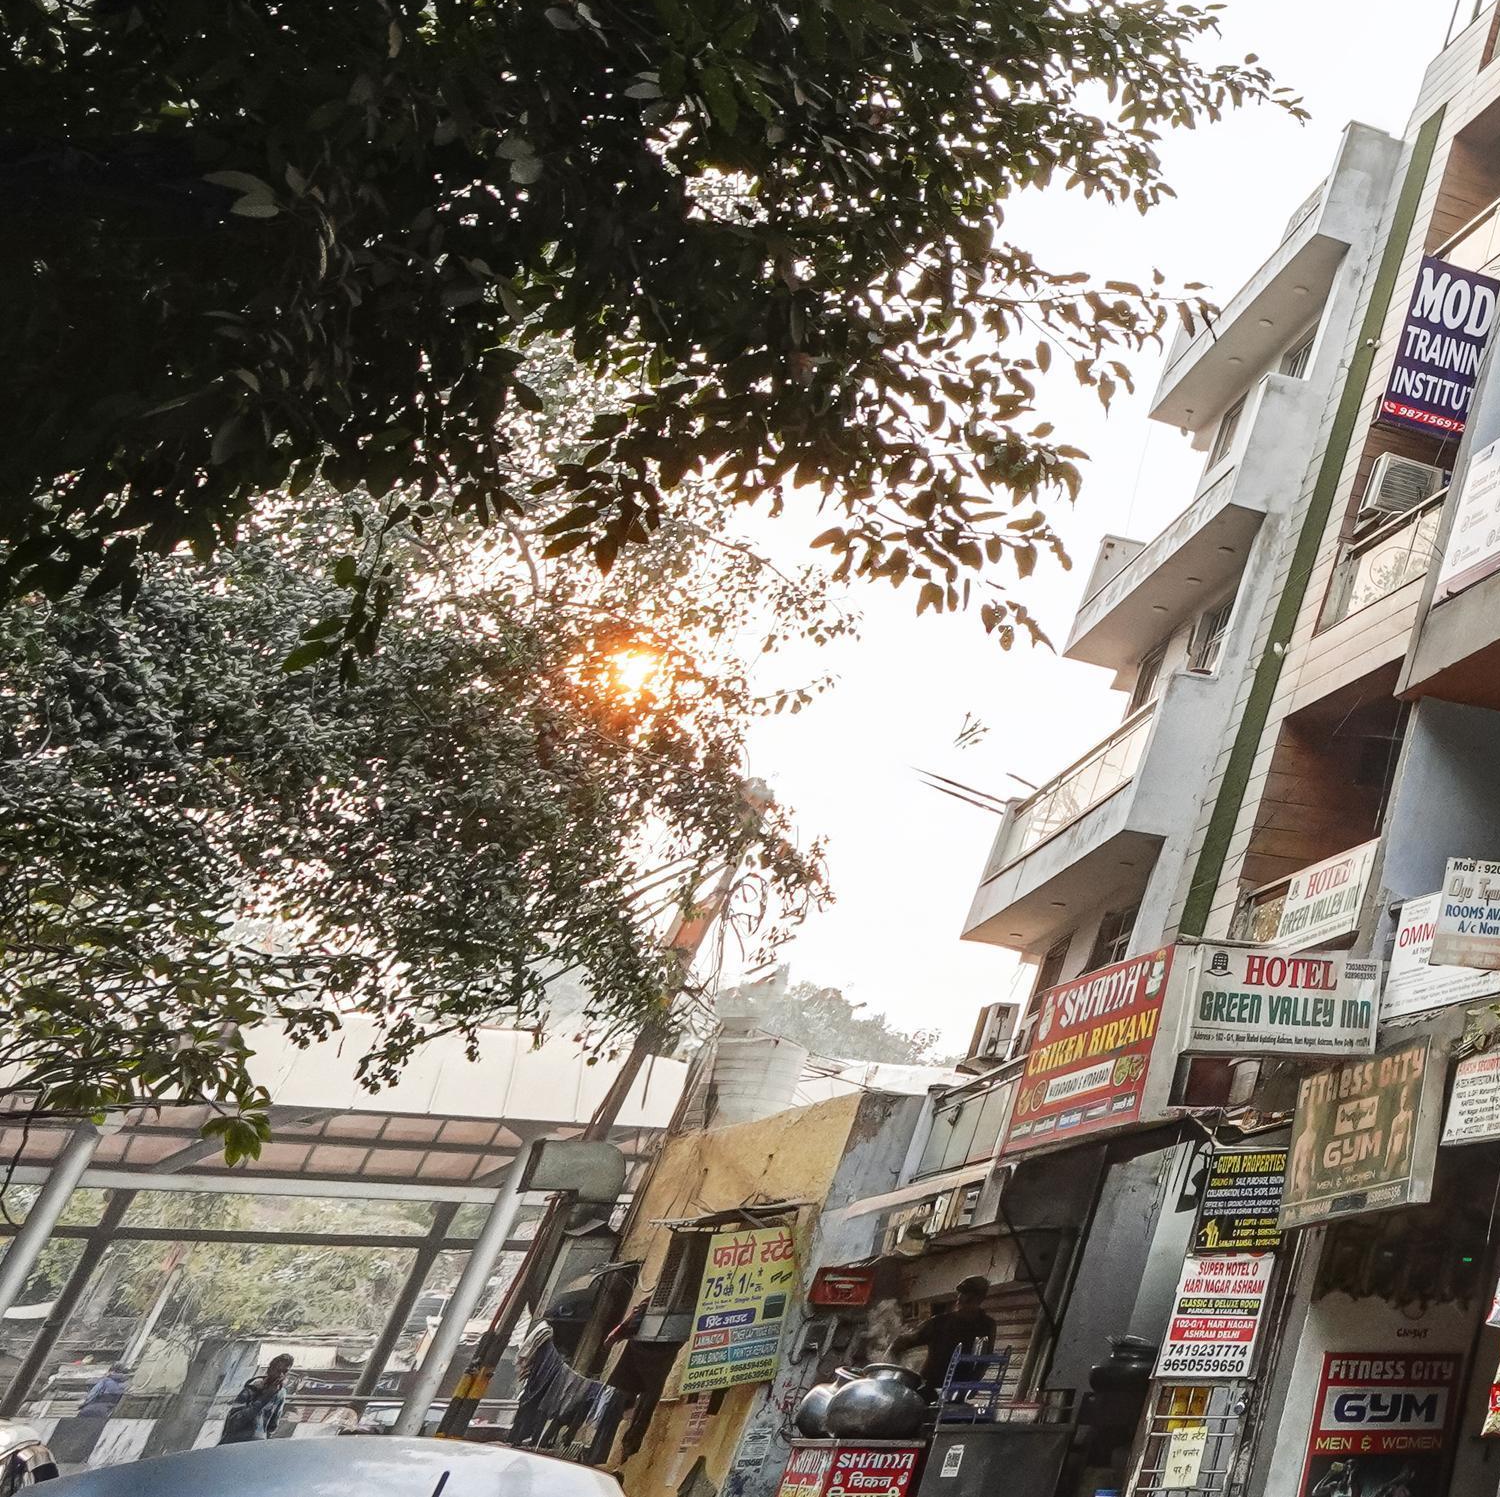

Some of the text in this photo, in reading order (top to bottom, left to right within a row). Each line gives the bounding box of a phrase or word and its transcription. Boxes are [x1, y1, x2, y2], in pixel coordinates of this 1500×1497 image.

[1412, 267, 1496, 337] MOD
[1453, 861, 1475, 872] Mob
[1445, 904, 1485, 917] ROOMS
[1457, 921, 1476, 933] A/c
[1479, 923, 1499, 935] Non
[1243, 955, 1338, 991] HOTEL
[1200, 991, 1335, 1028] GREEN VALLEY
[1087, 1008, 1158, 1057] BIRYANI
[1323, 1130, 1383, 1169] GYM
[1217, 1154, 1287, 1173] GUPTA PROPERTIES
[712, 1234, 757, 1268] फोटो
[1198, 1262, 1250, 1276] SUPER HOTEL
[705, 1276, 724, 1299] 75
[1183, 1279, 1265, 1294] HARI NAGAR ASHRAM
[1180, 1299, 1260, 1309] CLASSIC DELUXE ROOM
[1226, 1320, 1254, 1329] NAGAR
[1183, 1330, 1240, 1338] ASHRAM DELHI
[1169, 1344, 1248, 1357] 7419237774
[1163, 1359, 1244, 1372] 9650559650
[688, 1368, 723, 1379] CONTACT
[1334, 1393, 1439, 1423] GYM
[1315, 1437, 1442, 1450] MEN WOMEN
[836, 1453, 915, 1469] SHAMA
[848, 1471, 894, 1488] चिकन
